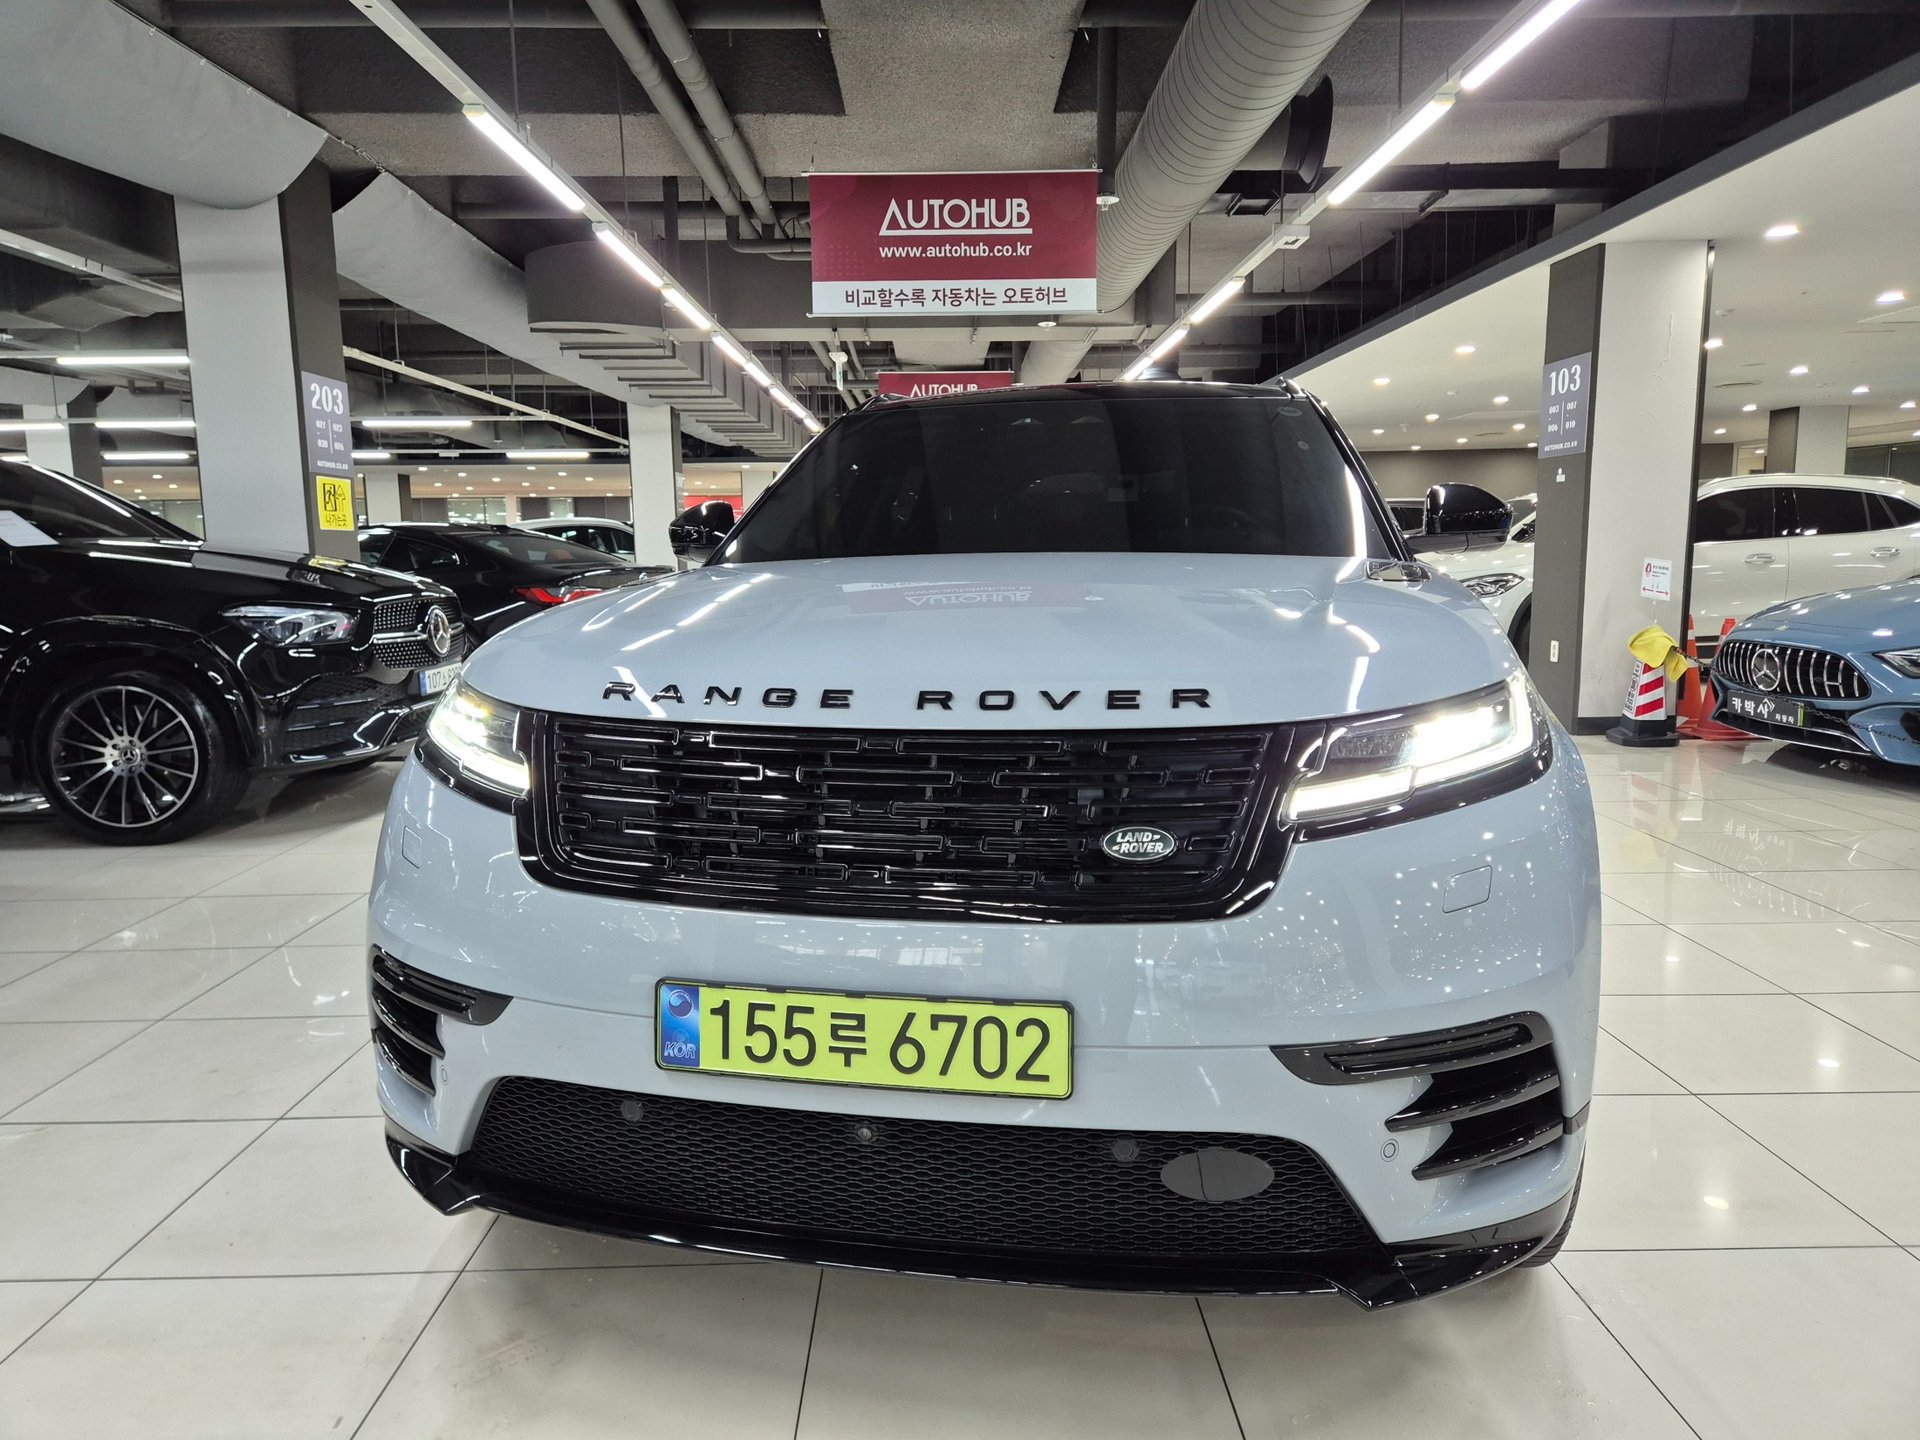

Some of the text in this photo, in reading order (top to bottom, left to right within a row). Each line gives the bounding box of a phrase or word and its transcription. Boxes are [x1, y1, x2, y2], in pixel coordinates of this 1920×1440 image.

[879, 198, 1032, 236] AUTOHUB
[879, 241, 1032, 258] www.autohub.co.kr
[845, 286, 1068, 308] 비교할수록 자동차는 오토허브
[1549, 364, 1581, 396] 103
[310, 383, 344, 415] 203
[1565, 420, 1576, 429] 010
[602, 681, 1210, 710] RANGE ROVER
[1731, 697, 1769, 719] 카박사
[1116, 832, 1153, 842] LAND
[1120, 842, 1163, 853] ROVER
[664, 1041, 696, 1059] KOR
[710, 999, 1050, 1083] 155루 6702
